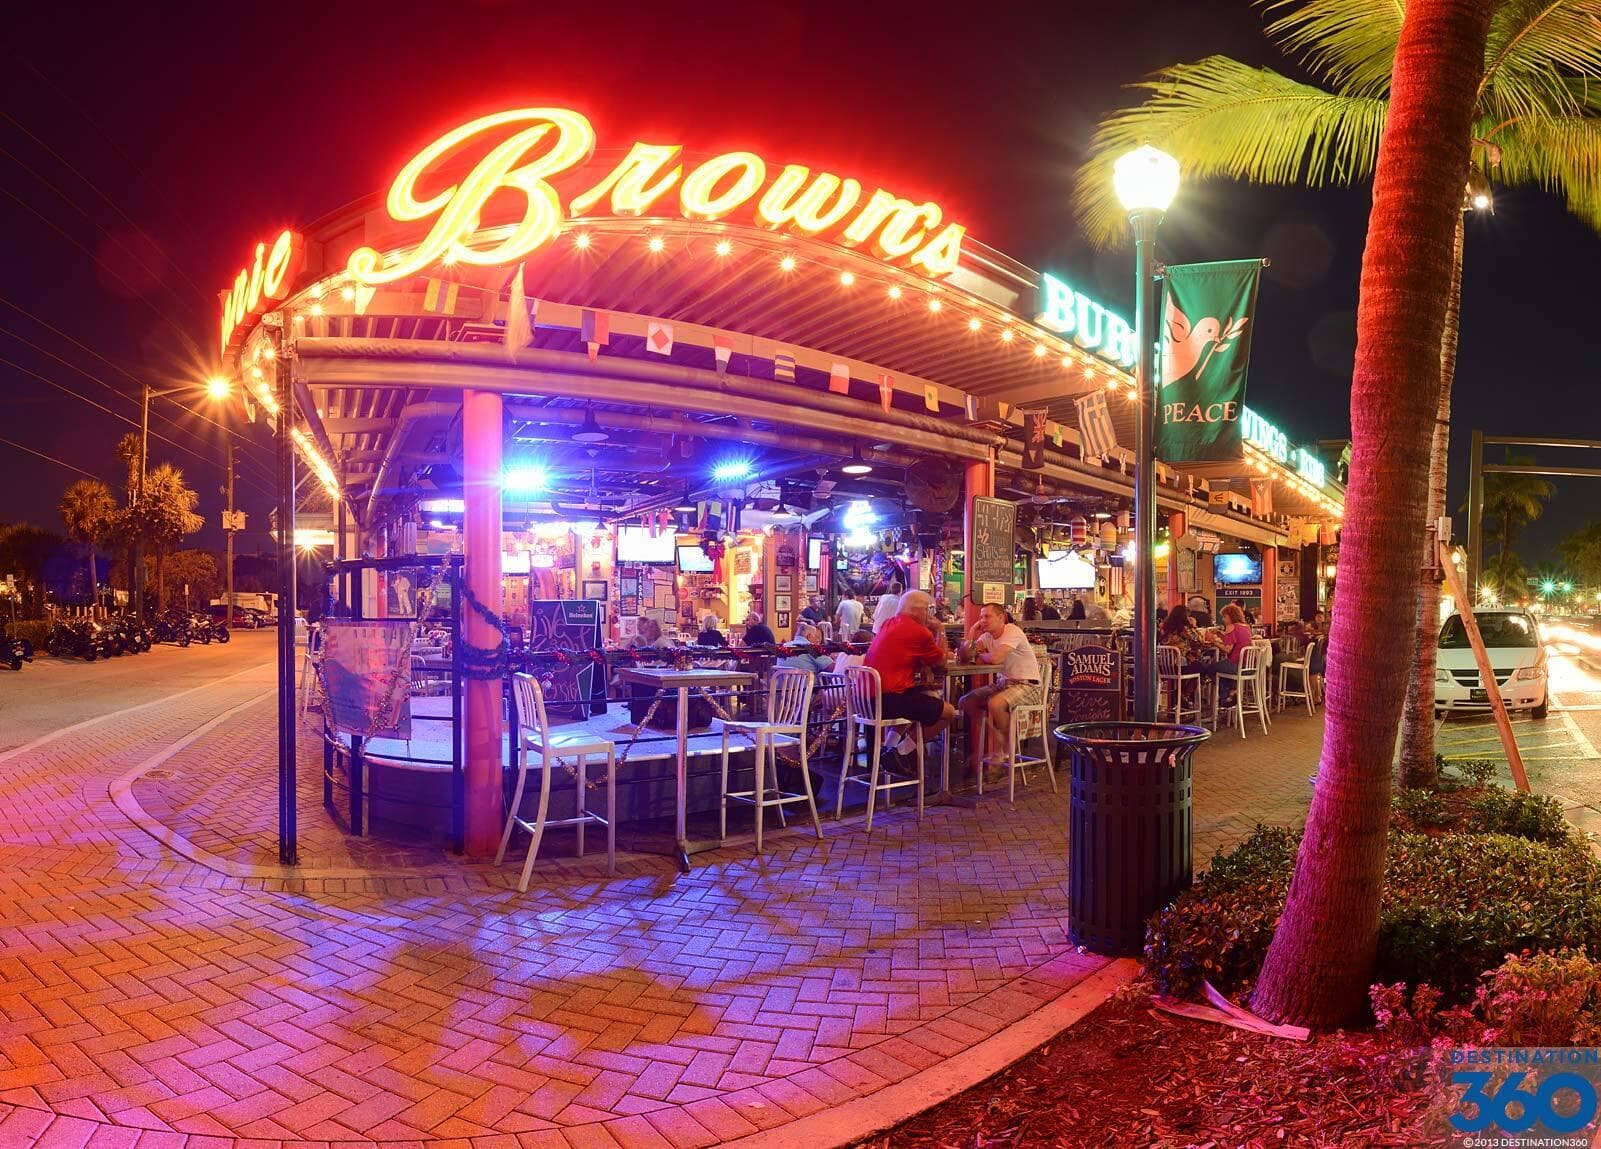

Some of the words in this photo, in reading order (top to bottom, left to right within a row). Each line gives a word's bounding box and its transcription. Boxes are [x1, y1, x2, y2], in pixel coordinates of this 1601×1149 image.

[1042, 272, 1137, 368] BUR
[1163, 401, 1239, 425] PEACE
[1068, 652, 1115, 666] SAMUEL
[1070, 664, 1111, 677] ADAMS
[1092, 676, 1112, 684] LAGER
